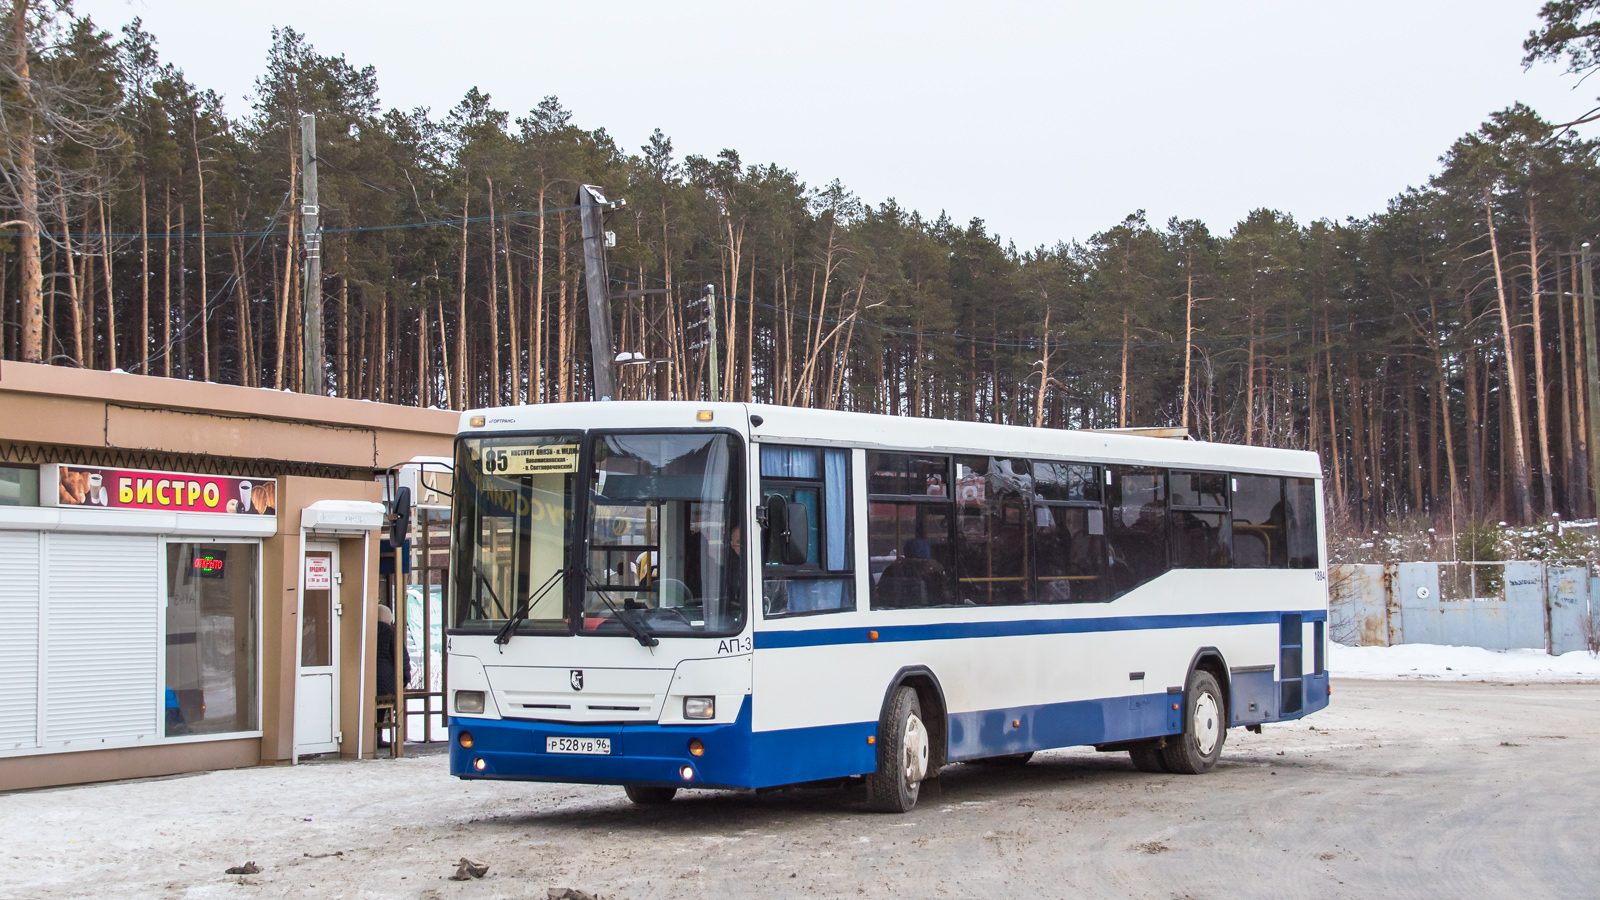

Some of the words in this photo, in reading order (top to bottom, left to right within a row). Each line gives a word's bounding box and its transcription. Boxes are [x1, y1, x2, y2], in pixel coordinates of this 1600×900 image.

[486, 450, 508, 472] 85
[119, 476, 220, 508] БИСТРО
[194, 558, 223, 570] ОТКРЫТО
[717, 636, 752, 655] АП-3
